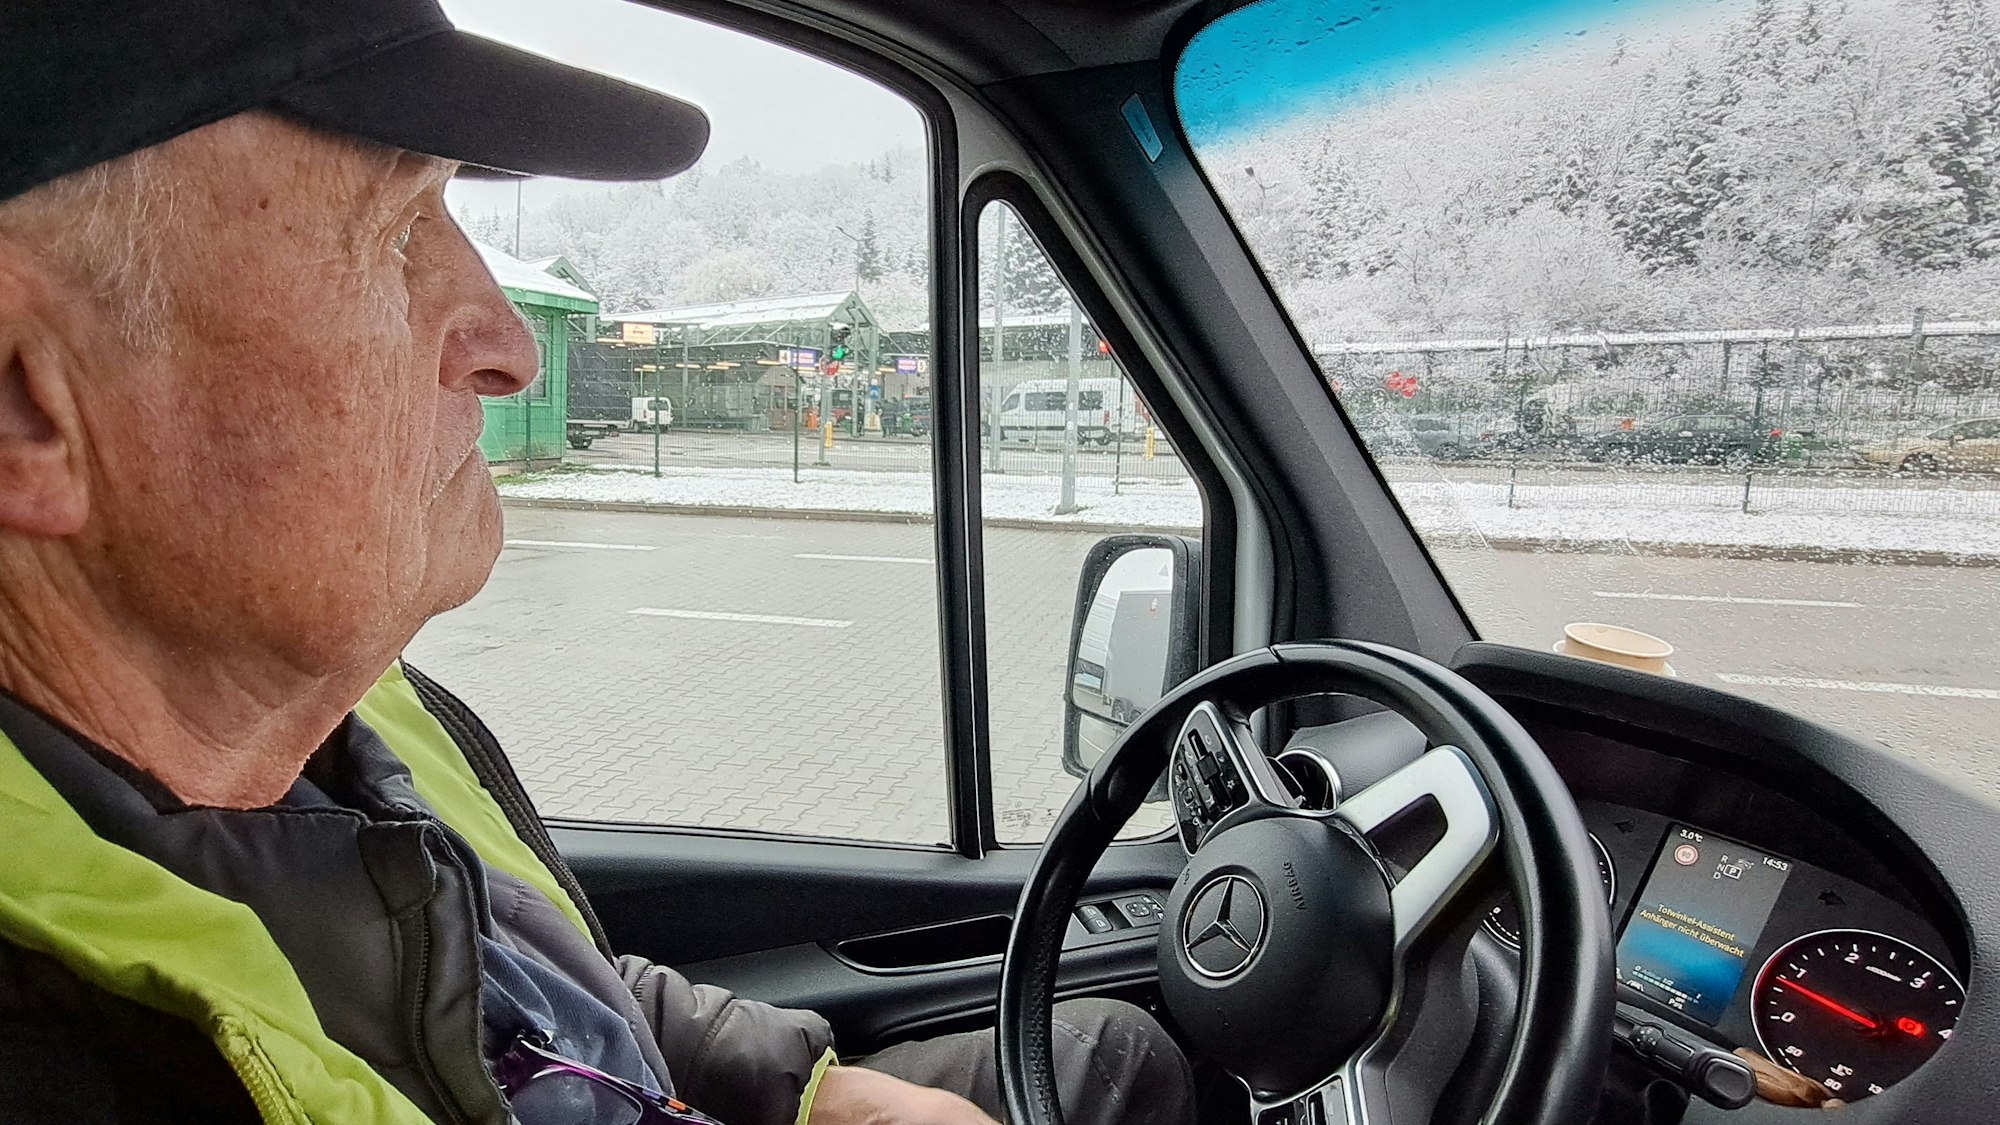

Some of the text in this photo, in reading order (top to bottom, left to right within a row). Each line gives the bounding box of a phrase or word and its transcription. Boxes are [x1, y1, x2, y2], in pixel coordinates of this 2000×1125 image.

[1682, 850, 1691, 859] 90
[1720, 855, 1729, 863] R
[1716, 864, 1725, 872] N
[1762, 857, 1788, 871] 14:53
[1712, 872, 1721, 880] D
[1282, 860, 1307, 910] AIRBAG
[1658, 904, 1735, 941] Totwinkel-Assistent
[1640, 909, 1745, 957] Anhänger nicht überwacht
[1844, 952, 1859, 964] 2
[1796, 968, 1807, 979] 1
[1909, 977, 1925, 989] 3
[1781, 1012, 1796, 1023] 0
[1938, 1029, 1953, 1040] 4
[1785, 1045, 1804, 1058] 50
[1823, 1078, 1842, 1091] 90
[1868, 1083, 1884, 1095] 13
